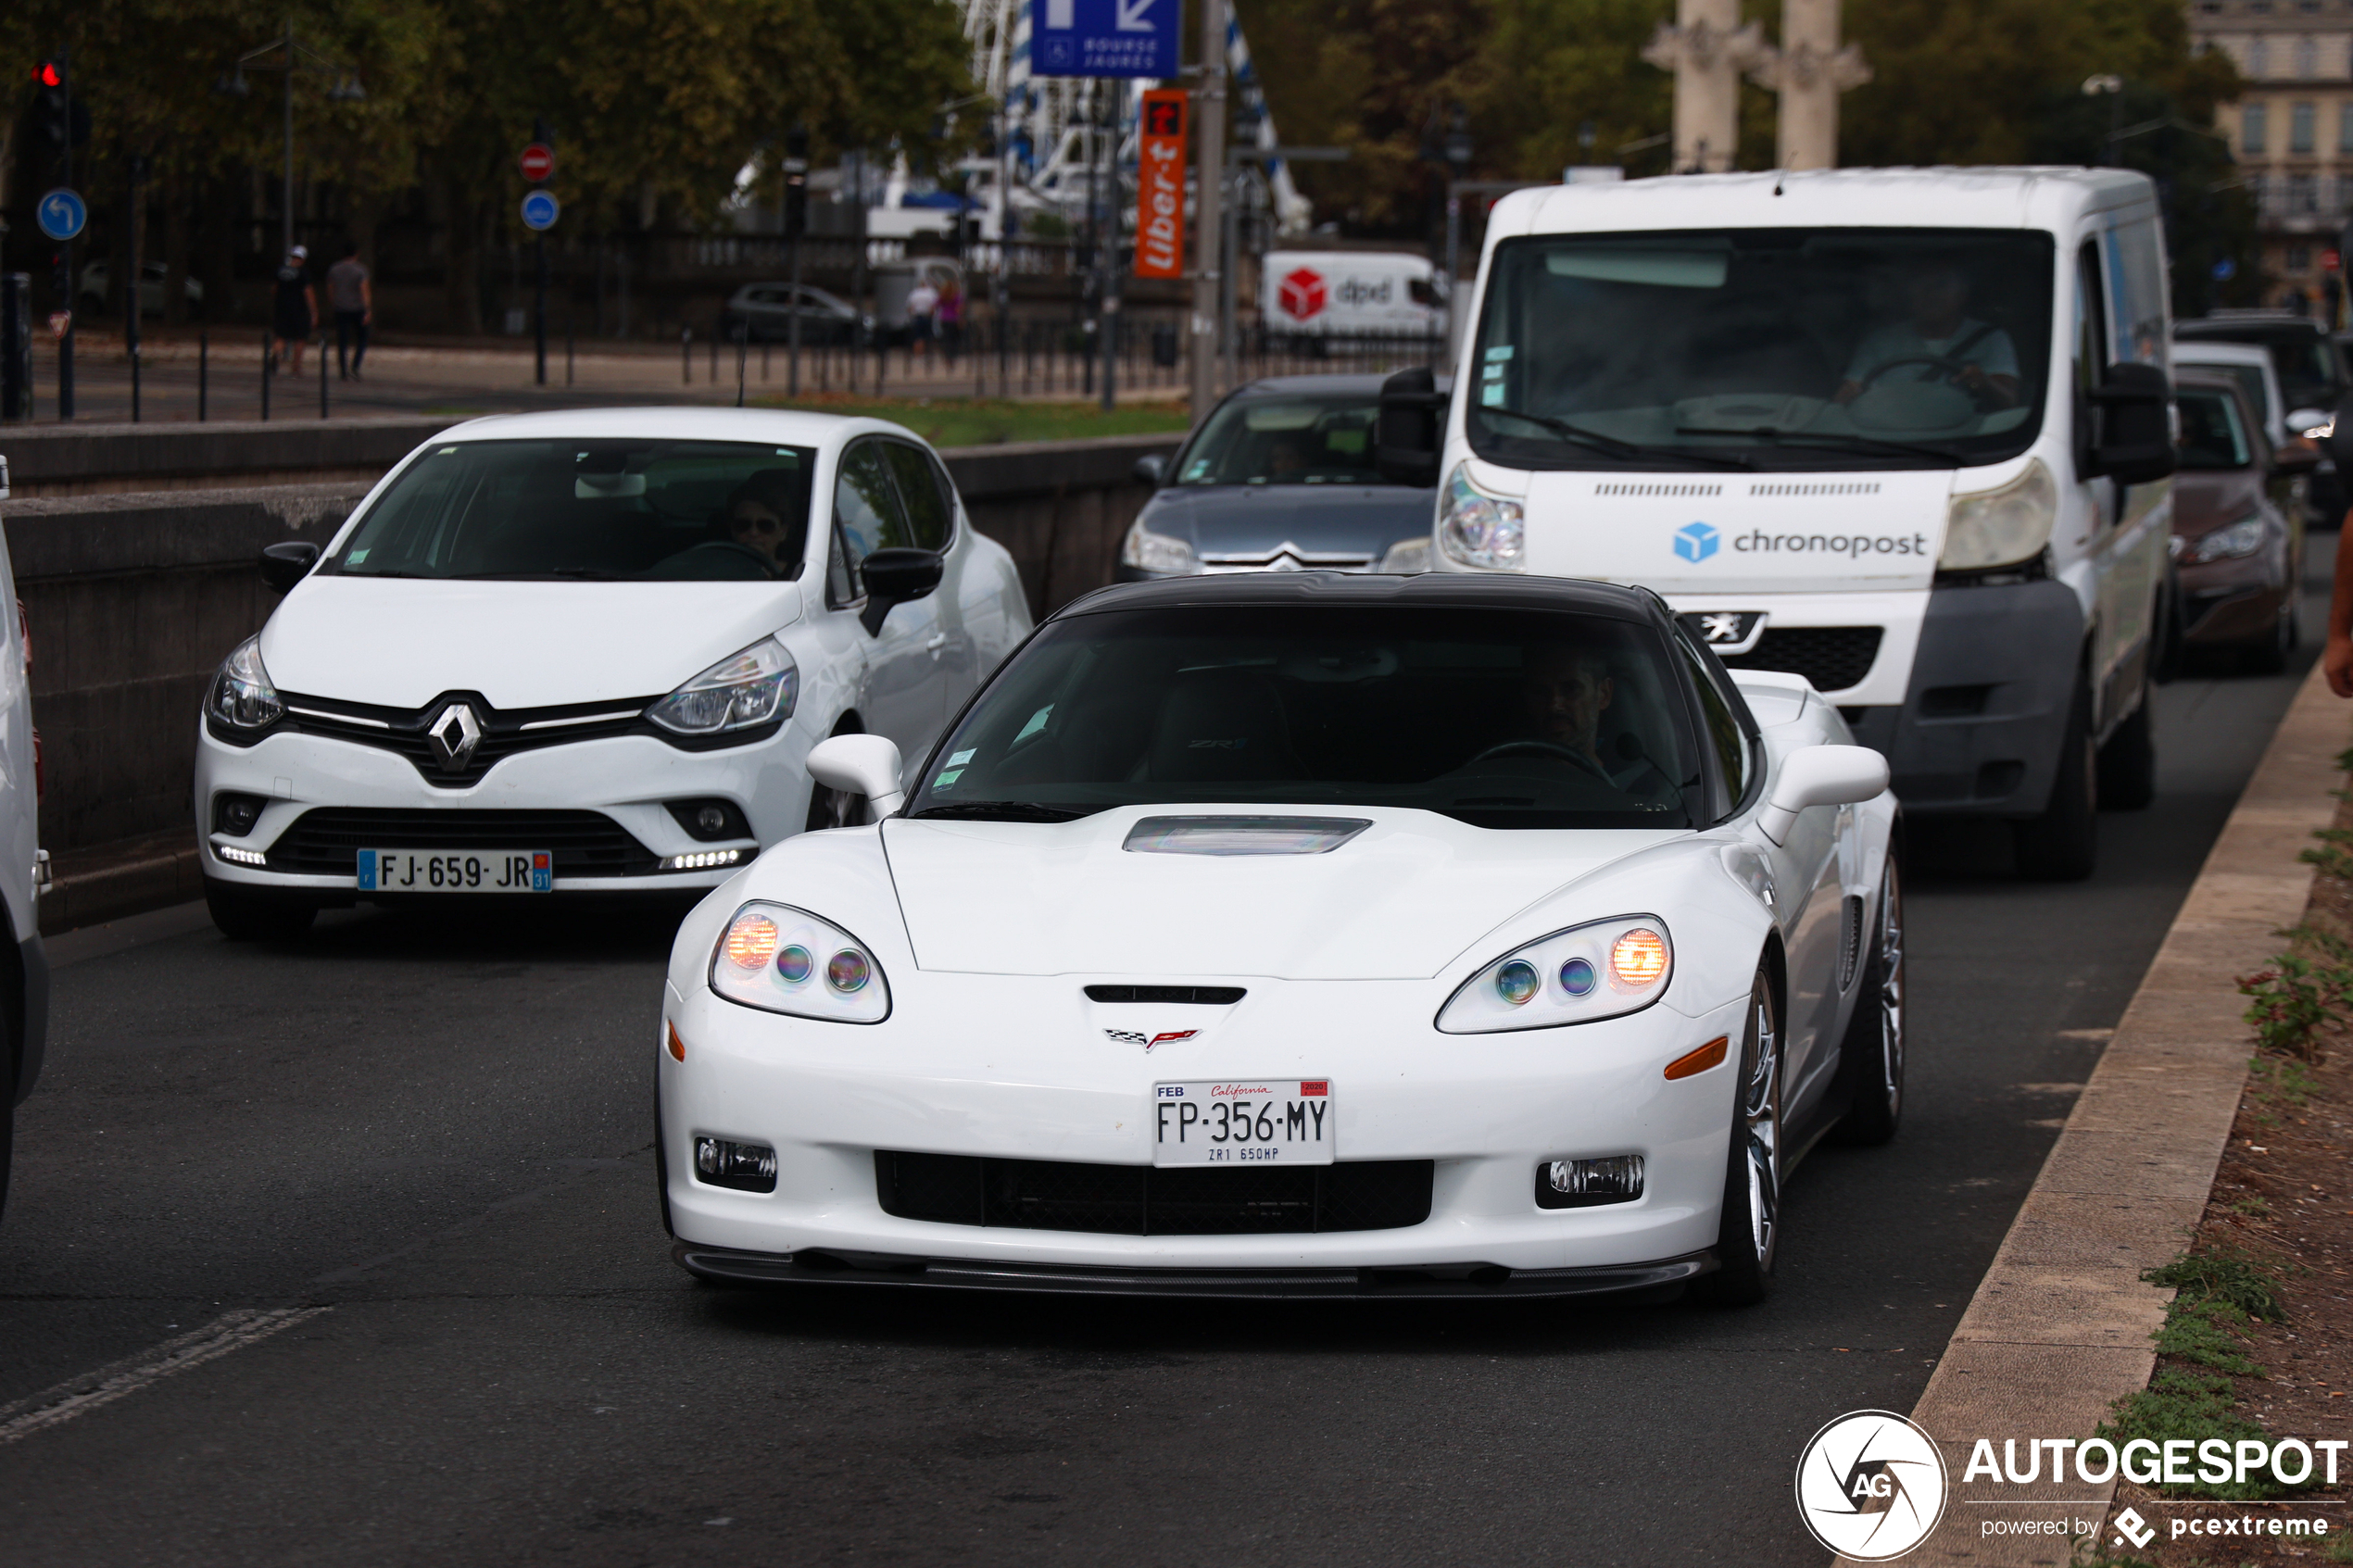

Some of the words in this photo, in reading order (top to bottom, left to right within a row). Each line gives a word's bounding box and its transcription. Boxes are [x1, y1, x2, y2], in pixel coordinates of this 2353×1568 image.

[1083, 37, 1158, 53] BOURSE
[1336, 277, 1390, 306] dpd
[1734, 528, 1929, 559] chronopost
[535, 873, 549, 888] 31
[1157, 1086, 1184, 1098] FEB
[1211, 1084, 1274, 1100] California
[1208, 1148, 1230, 1160] ZR1
[1240, 1148, 1278, 1160] 650HP
